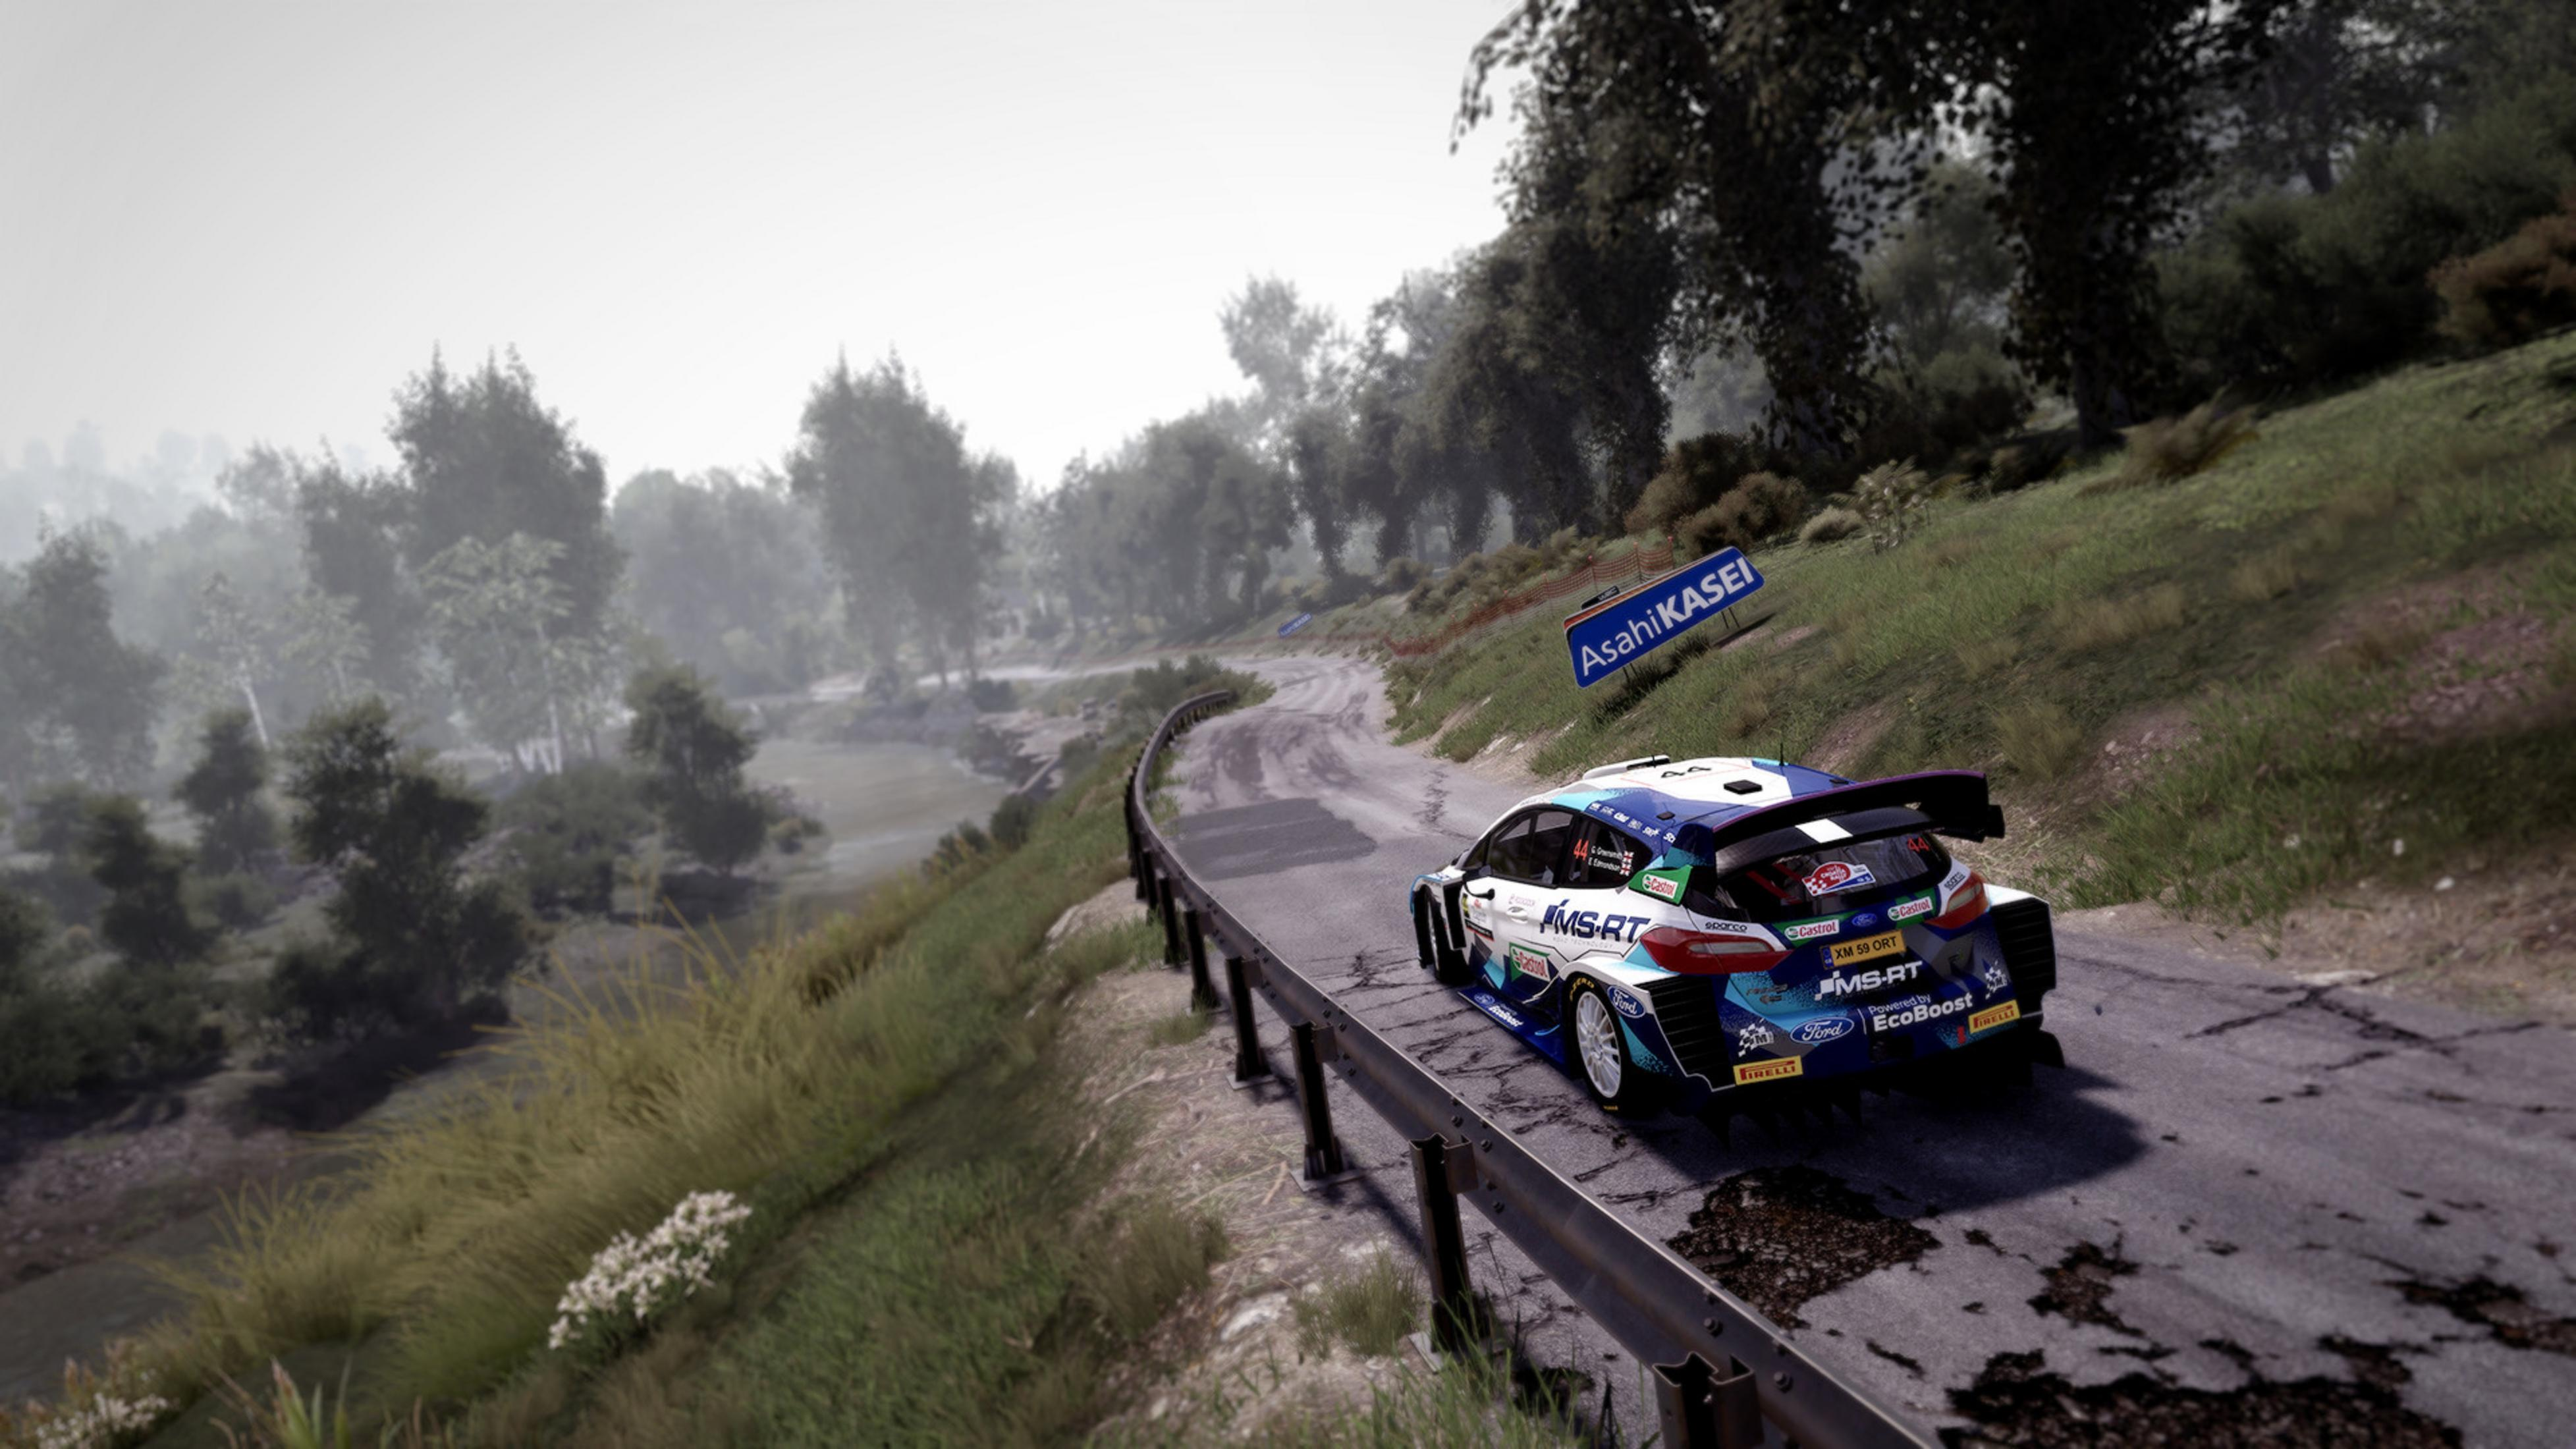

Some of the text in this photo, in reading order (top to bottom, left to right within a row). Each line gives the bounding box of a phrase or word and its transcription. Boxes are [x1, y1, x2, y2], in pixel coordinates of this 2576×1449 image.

[1573, 839, 1589, 860] 44
[1907, 836, 1929, 852] 44
[1651, 878, 1676, 897] Castrol
[1900, 899, 1931, 917] Castrol
[1799, 922, 1836, 937] Castrol
[1834, 936, 1898, 960] XM 59 ORT
[1520, 952, 1548, 978] Castrol
[1613, 989, 1638, 1015] Ford
[1868, 993, 1931, 1015] Powered by
[1873, 992, 1973, 1032] EcoBoost
[1972, 1004, 2015, 1029] PIRELLI
[1801, 1020, 1843, 1041] Ford
[1740, 1060, 1796, 1081] PIRELLI
